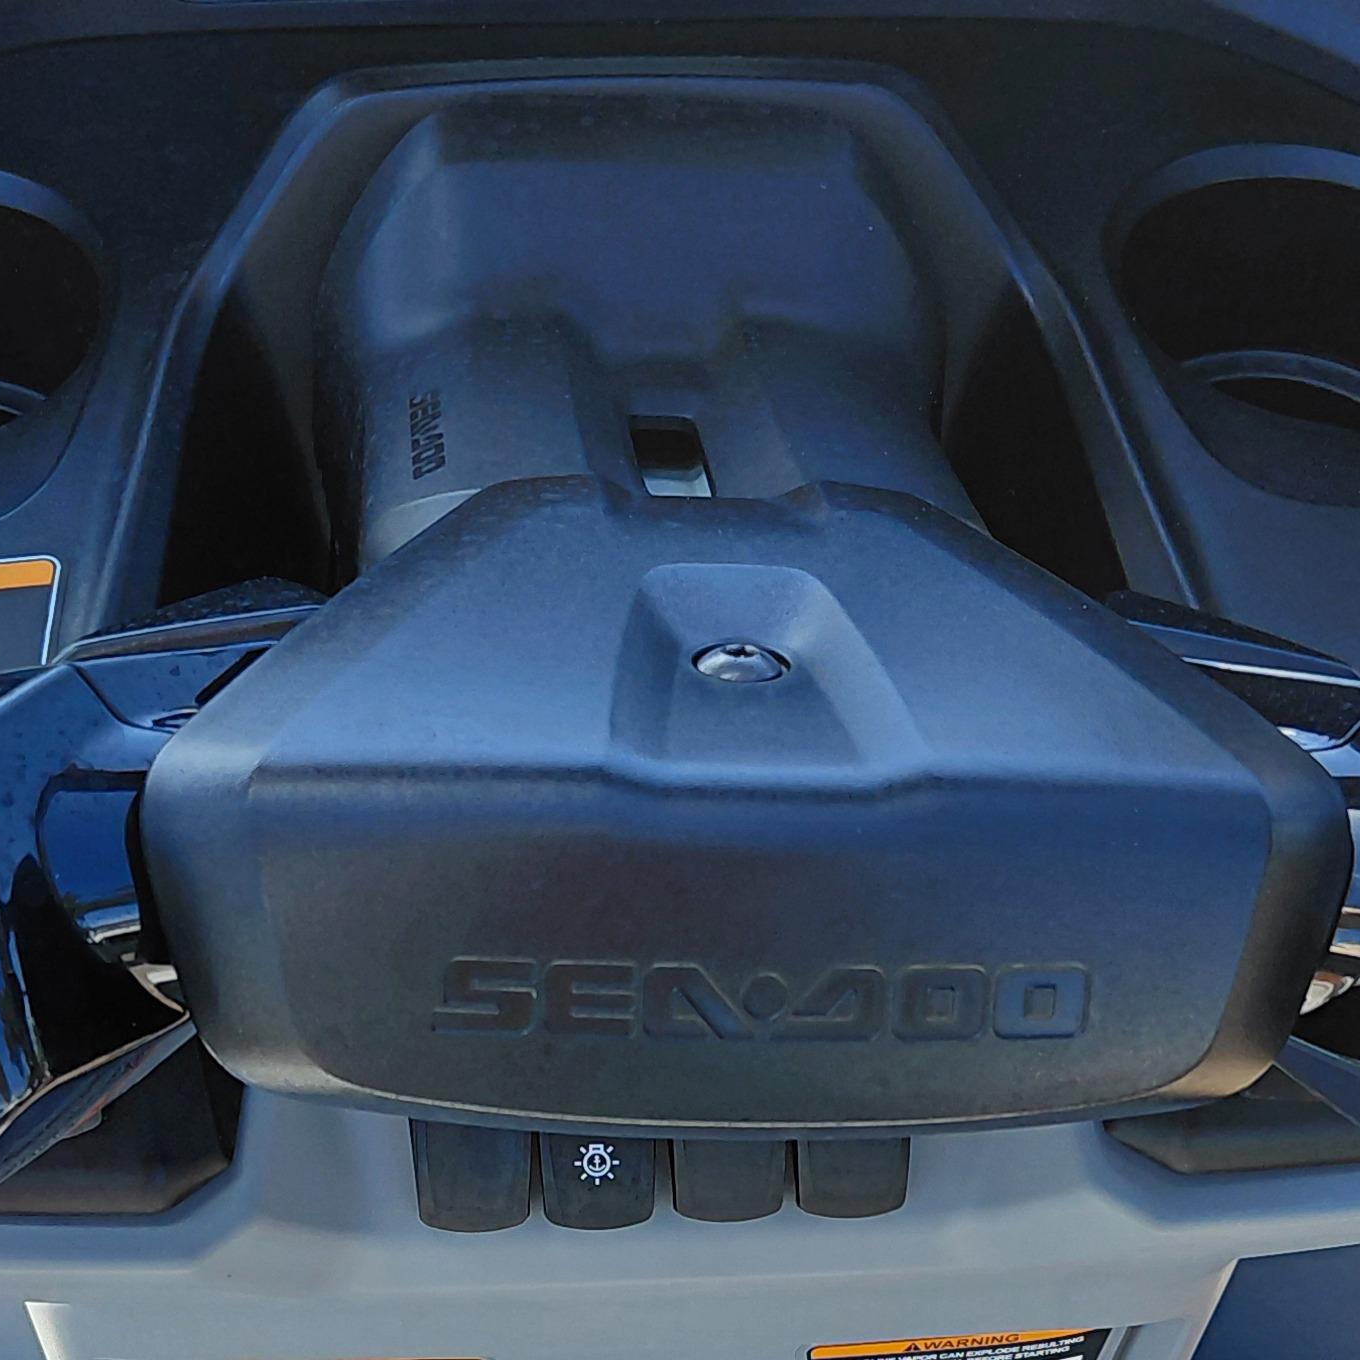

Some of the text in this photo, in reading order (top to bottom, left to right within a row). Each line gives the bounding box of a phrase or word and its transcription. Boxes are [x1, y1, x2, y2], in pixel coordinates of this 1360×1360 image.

[924, 1333, 1020, 1350] WARNING
[940, 1351, 964, 1359] CAN
[966, 1346, 1020, 1357] EXPLODE
[1022, 1336, 1085, 1351] RESULTING
[1015, 1346, 1071, 1360] STARTING
